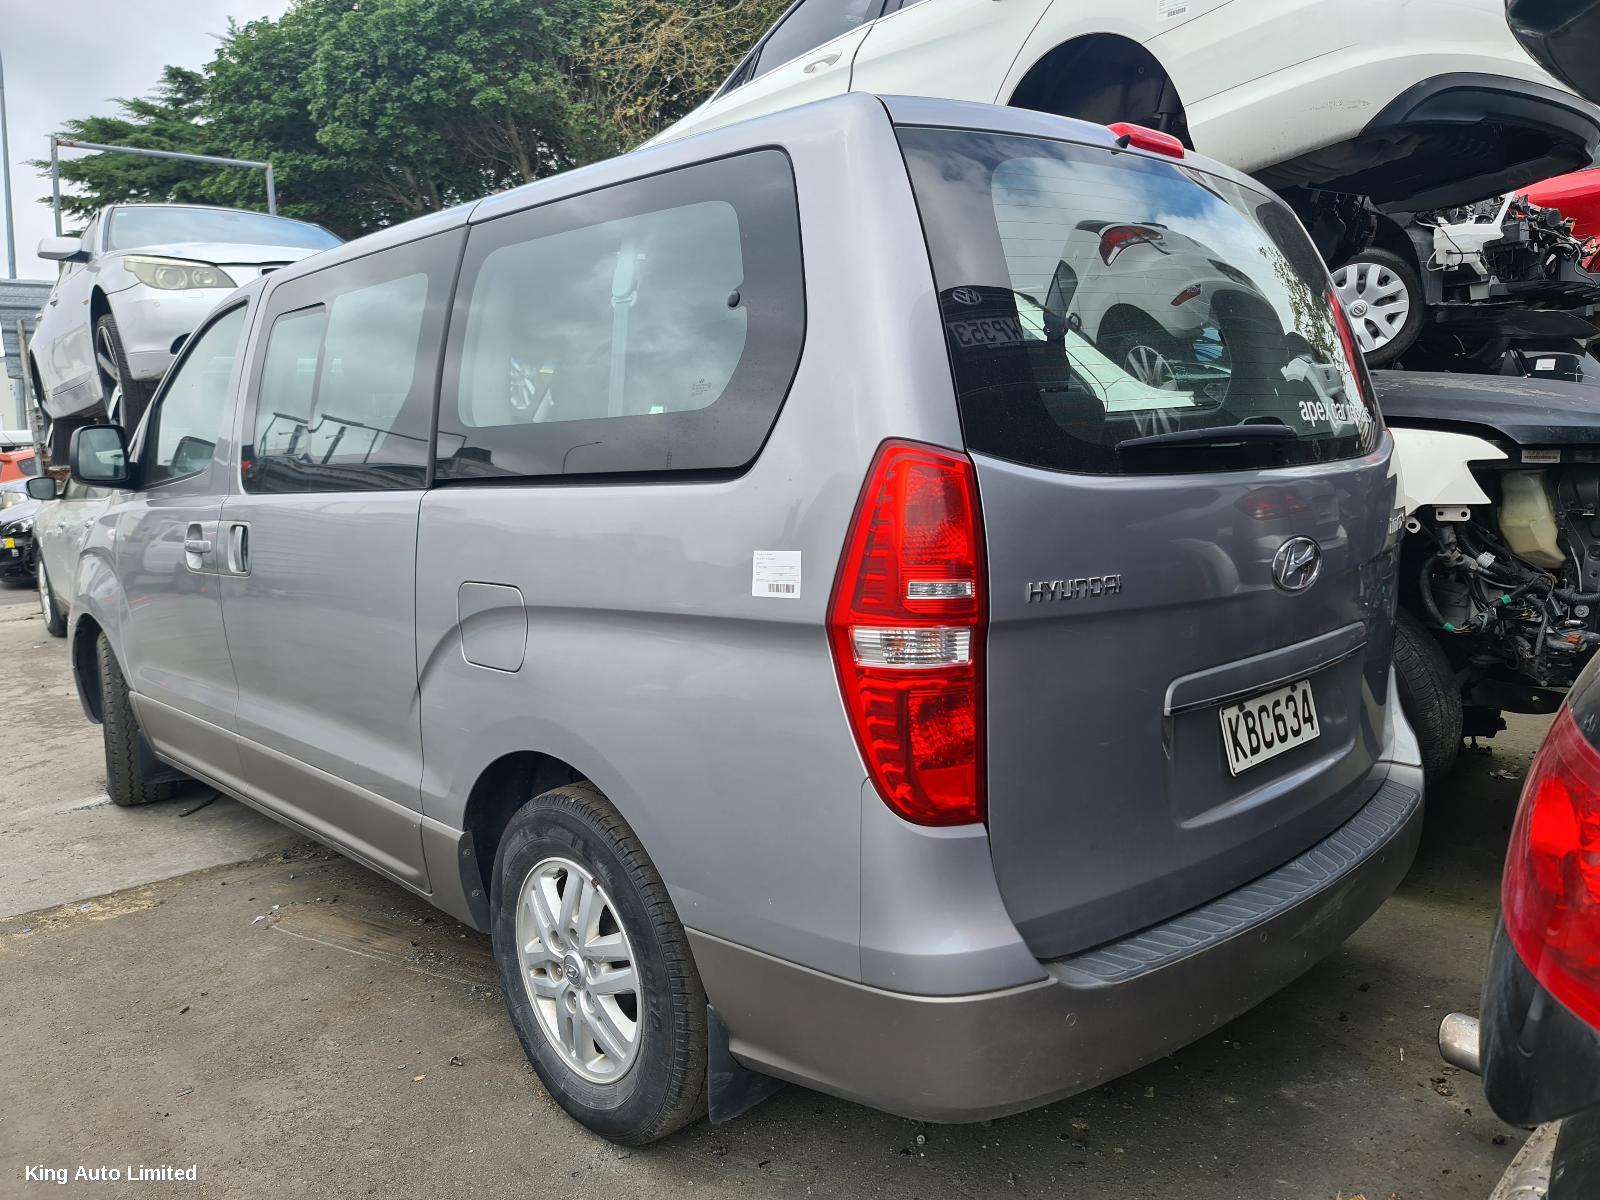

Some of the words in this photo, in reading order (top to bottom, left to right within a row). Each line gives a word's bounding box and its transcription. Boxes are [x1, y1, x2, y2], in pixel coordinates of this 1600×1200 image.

[1298, 400, 1337, 428] apex
[1331, 402, 1347, 420] car
[1025, 575, 1121, 603] HYUNDAI
[1227, 688, 1315, 763] KBC634
